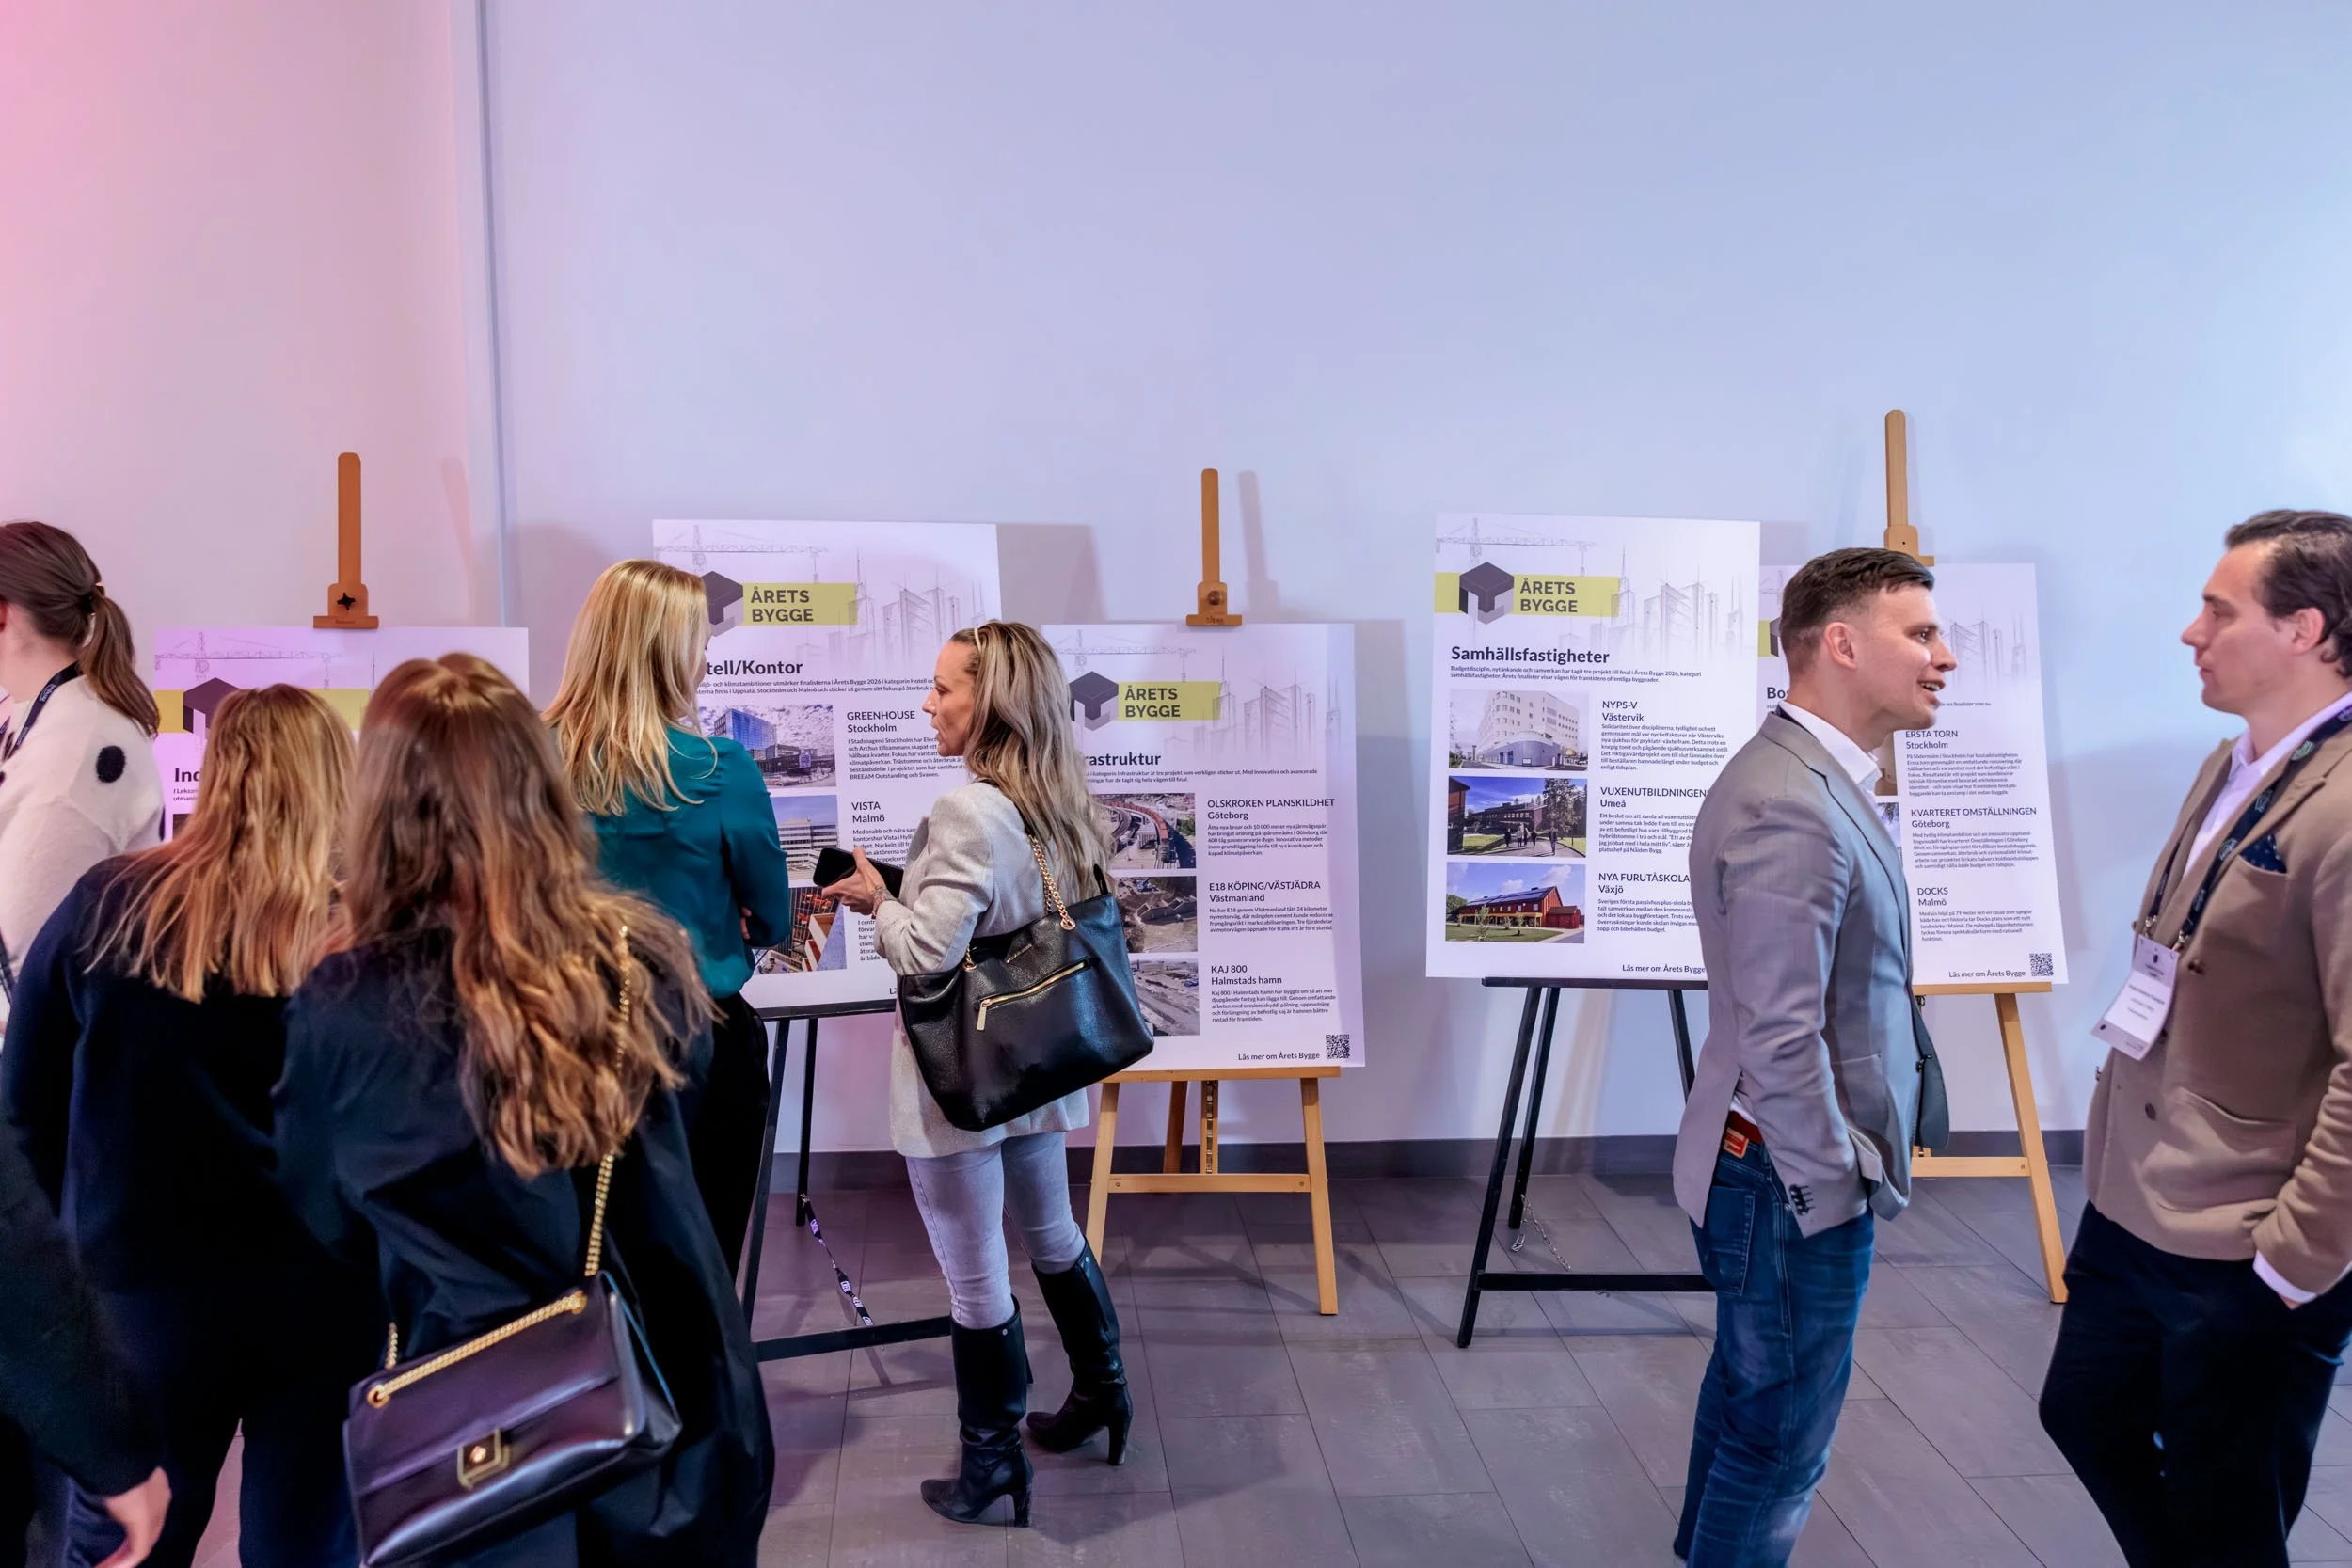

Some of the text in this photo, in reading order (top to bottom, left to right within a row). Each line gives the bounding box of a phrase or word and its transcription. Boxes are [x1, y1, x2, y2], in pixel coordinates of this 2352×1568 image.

[1520, 577, 1575, 595] ÅRETS
[750, 586, 810, 603] ÅRETS
[1520, 598, 1578, 613] BYGGE
[752, 608, 814, 623] BYGGE
[1451, 646, 1610, 665] Samhällsfastigheter
[707, 660, 803, 676] tell/Kontor
[1125, 685, 1178, 700] ÅRETS
[1602, 700, 1638, 709] NYPS-V
[847, 710, 915, 720] GREENHOUSE
[1126, 704, 1181, 718] BYGGE
[1602, 713, 1644, 721] Västervik
[847, 724, 897, 733] Stockholm
[1906, 741, 1949, 749] Stockholm
[1085, 752, 1161, 766] astruktur
[851, 802, 881, 810] VISTA
[1207, 798, 1335, 808] OLSKROKEN PLANSKILDHET
[1600, 799, 1626, 808] Umeå
[1207, 811, 1249, 820] Göteborg
[1911, 806, 2037, 817] KVARTERET OMSTÄLLNINGEN
[852, 814, 885, 823] Malmö
[1912, 820, 1950, 828] Göteborg
[1598, 871, 1690, 882] NYA FURUTÅSKOLA
[1209, 880, 1321, 891] E18 KÖPING/VÄSTJÄDRA
[1598, 885, 1624, 895] Växjö
[1917, 887, 1949, 895] DOCKS
[1209, 893, 1265, 902] Västmanland
[1918, 898, 1947, 907] Malmö
[1231, 965, 1247, 973] 800
[1663, 964, 1683, 972] Årets
[1684, 965, 1705, 974] Bygge
[1987, 968, 2004, 977] Årets
[2006, 969, 2026, 977] Bygge
[1211, 976, 1257, 985] Halmstads
[1278, 1051, 1298, 1059] Årets
[1299, 1052, 1320, 1060] Bygge
